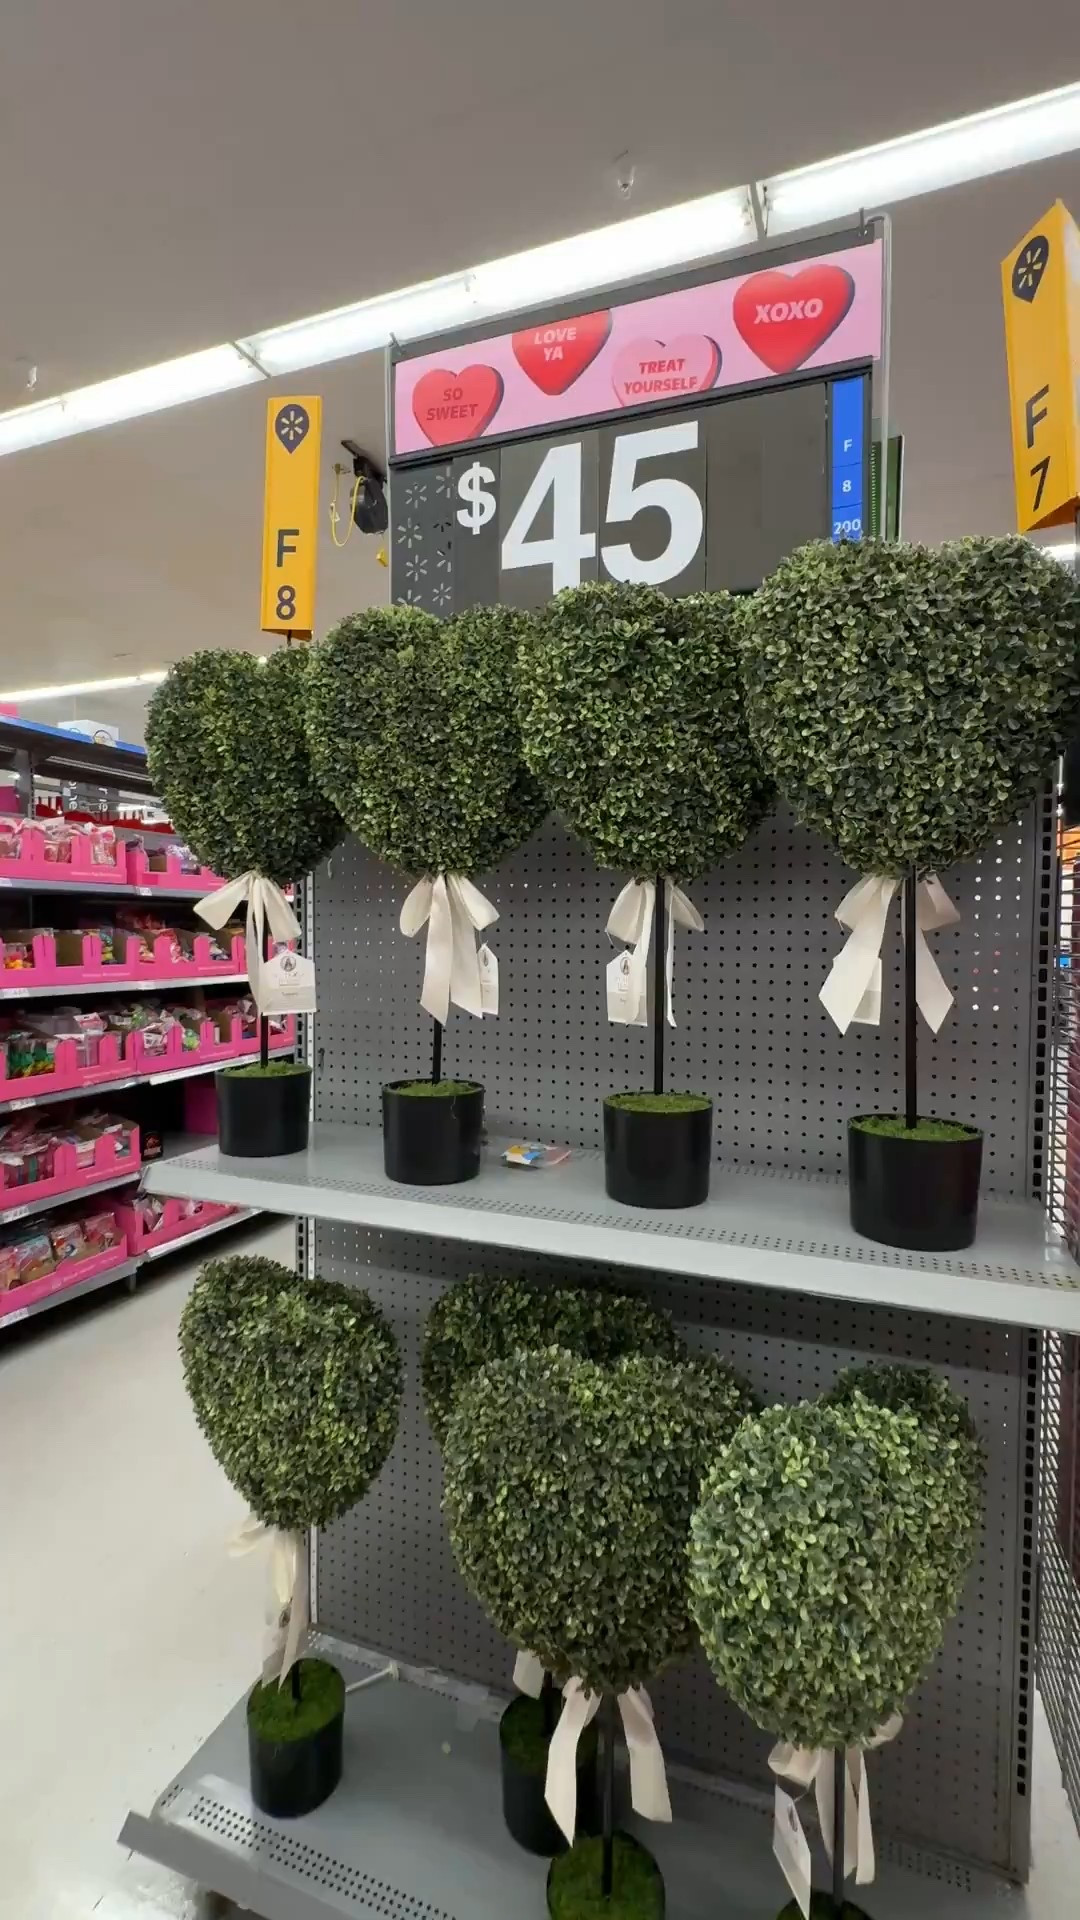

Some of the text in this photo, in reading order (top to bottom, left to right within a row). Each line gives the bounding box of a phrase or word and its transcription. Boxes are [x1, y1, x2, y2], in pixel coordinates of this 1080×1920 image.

[754, 297, 824, 325] XOXO
[533, 326, 578, 344] LOVE
[543, 345, 565, 362] YA
[638, 357, 685, 374] TREAT
[442, 387, 464, 402] SO
[624, 376, 698, 395] YOURSELF
[425, 403, 479, 421] SWEET
[1025, 383, 1050, 449] F
[843, 438, 853, 452] F
[842, 479, 852, 493] 8
[1030, 455, 1051, 512] 7
[833, 518, 862, 535] 200
[277, 529, 299, 567] F
[276, 586, 296, 620] 8
